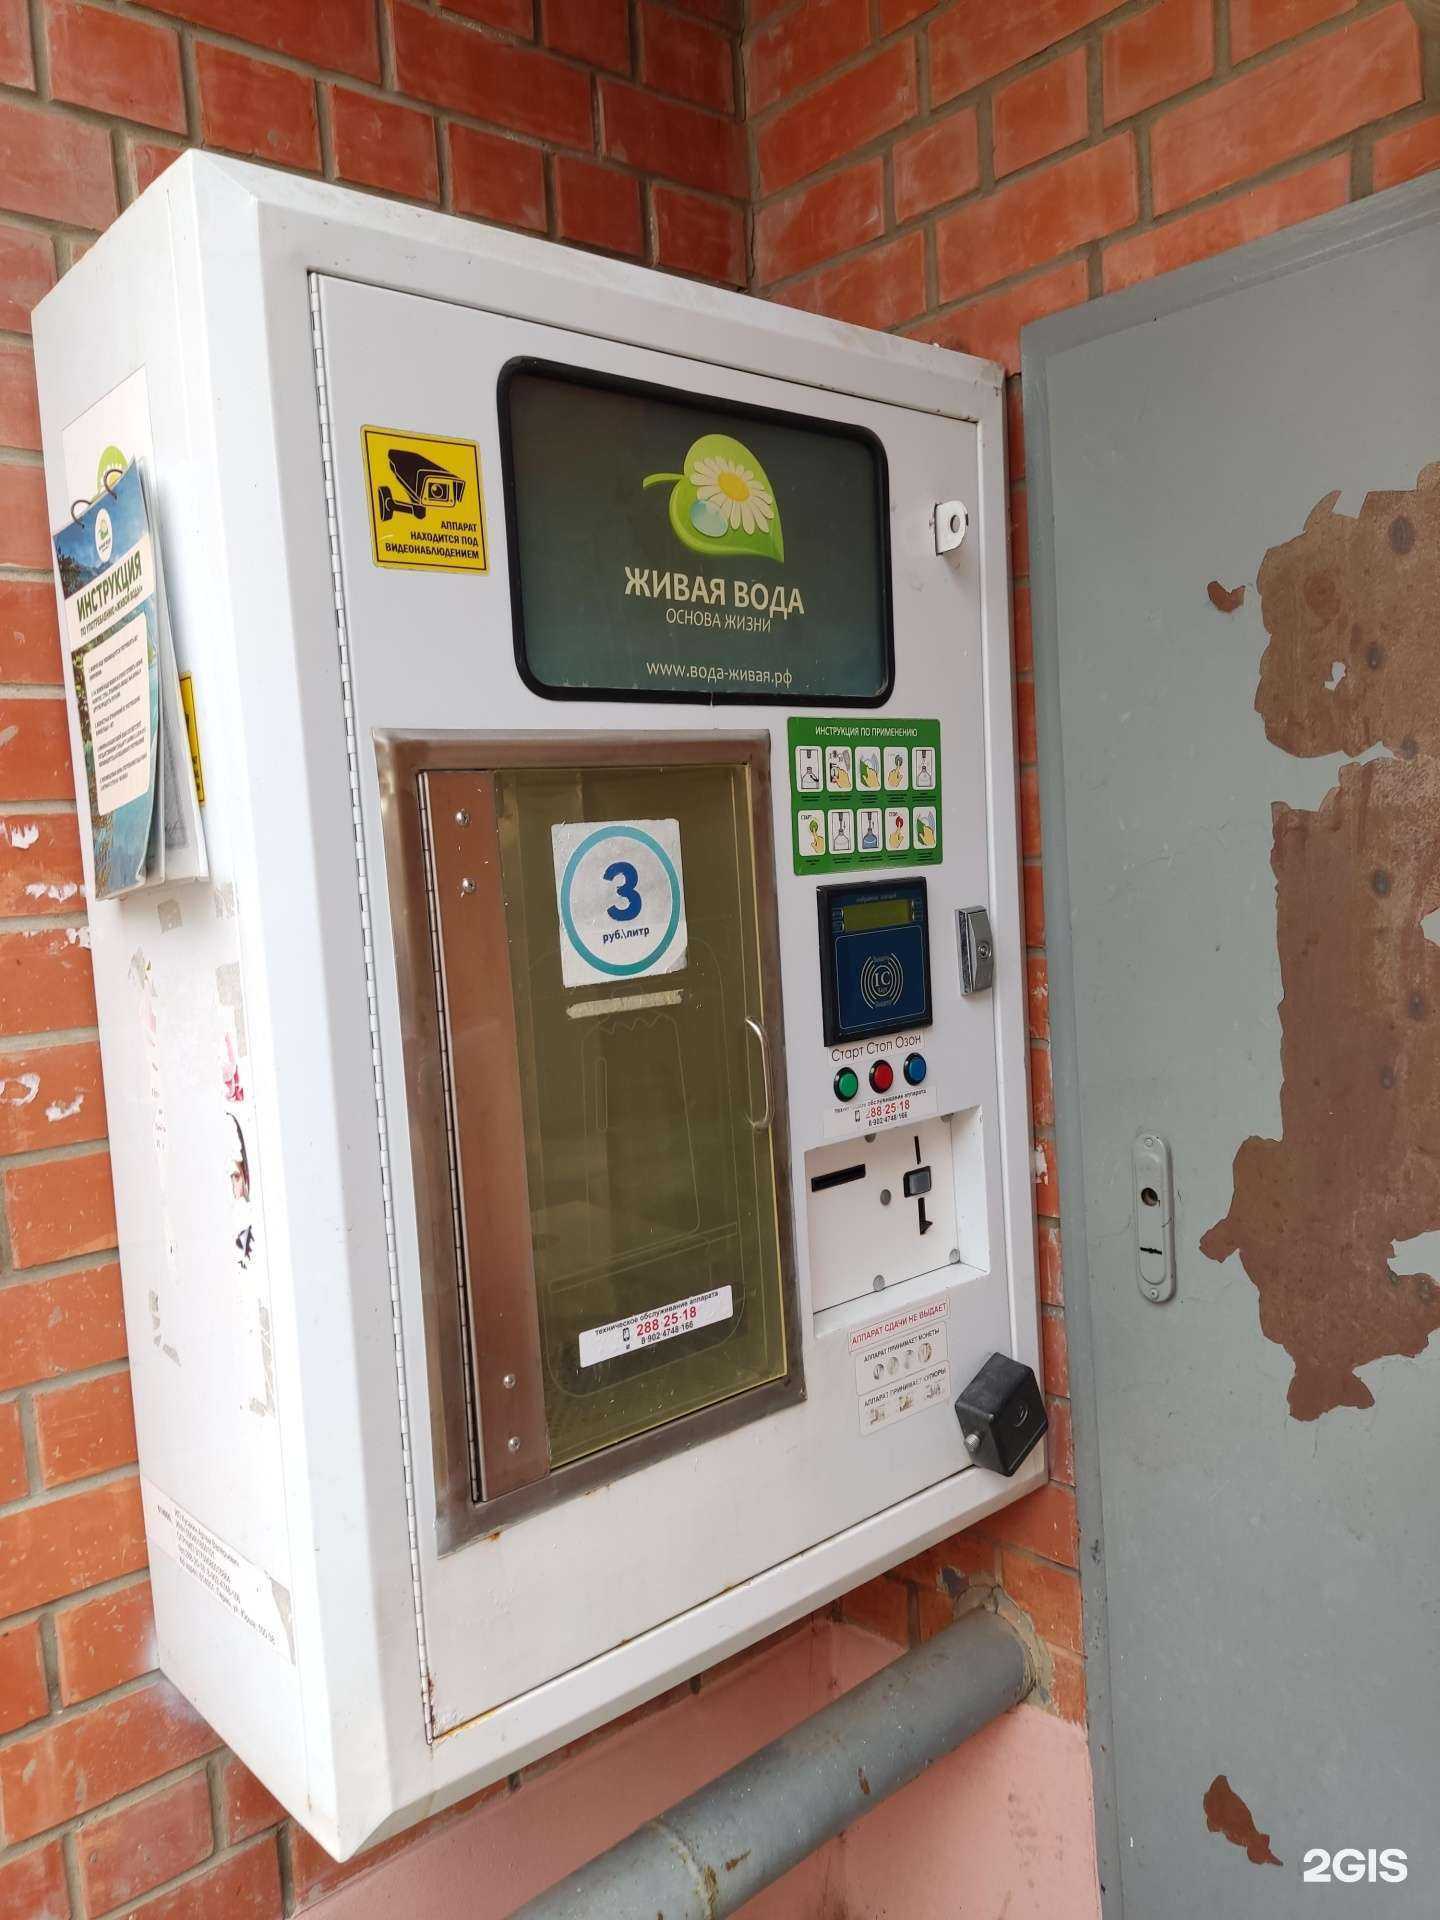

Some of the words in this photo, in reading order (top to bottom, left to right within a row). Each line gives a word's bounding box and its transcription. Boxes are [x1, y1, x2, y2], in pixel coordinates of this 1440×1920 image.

[441, 521, 477, 533] АППАРАТ
[410, 531, 460, 544] НАХОДИТСЯ
[462, 537, 478, 547] ПОД
[385, 542, 480, 559] ВИДЕОНАБЛЮДЕНИЕМ
[76, 550, 142, 622] ИНСТРУКЦИЯ
[624, 566, 726, 606] ЖИВАЯ
[733, 580, 805, 620] ВОДА
[666, 608, 721, 629] ОСНОВА
[724, 615, 771, 632] ЖИЗНИ
[646, 662, 793, 689] www.вода-живая.рф
[815, 726, 859, 738] ИНСТРУКЦИЯ
[861, 728, 871, 737] ПО
[872, 728, 918, 737] ПРИМЕНЕНИЮ
[603, 861, 642, 921] 3
[874, 971, 891, 987] IC
[831, 1046, 864, 1062] Старт
[867, 1039, 893, 1055] Стоп
[895, 1035, 921, 1049] Озон
[690, 1291, 719, 1304] аппарата
[852, 1326, 883, 1345] АППАРАТ
[884, 1316, 908, 1333] СДАЧИ
[908, 1313, 918, 1323] НЕ
[919, 1302, 947, 1320] ВЫДАЕТ
[864, 1348, 887, 1362] АППАРАТ
